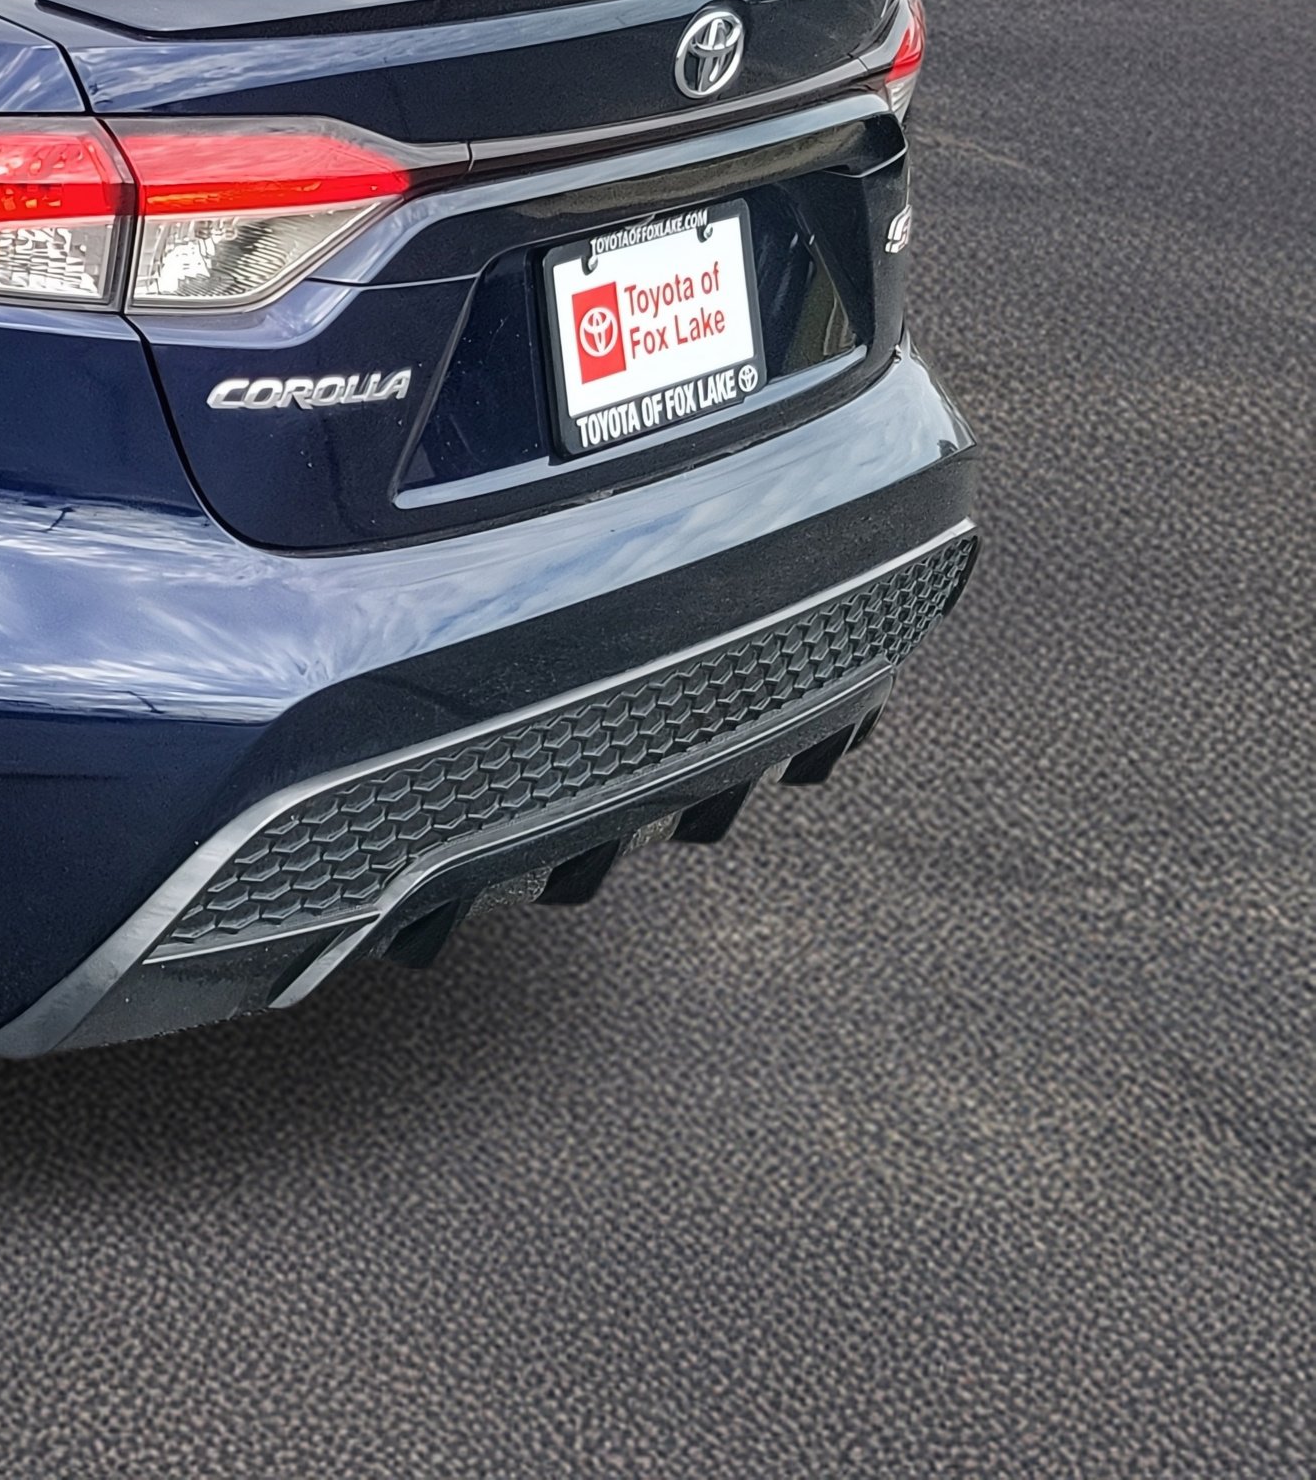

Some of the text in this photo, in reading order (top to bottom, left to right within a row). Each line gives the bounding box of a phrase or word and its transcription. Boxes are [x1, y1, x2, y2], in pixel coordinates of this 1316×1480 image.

[590, 208, 708, 256] TOYOTAOFFOXLAKE.COM
[624, 261, 720, 318] Toyota of
[630, 306, 726, 359] Fox Lake
[206, 368, 412, 409] COROLLA
[576, 369, 737, 448] TOYOTA OF FOX LAKE
